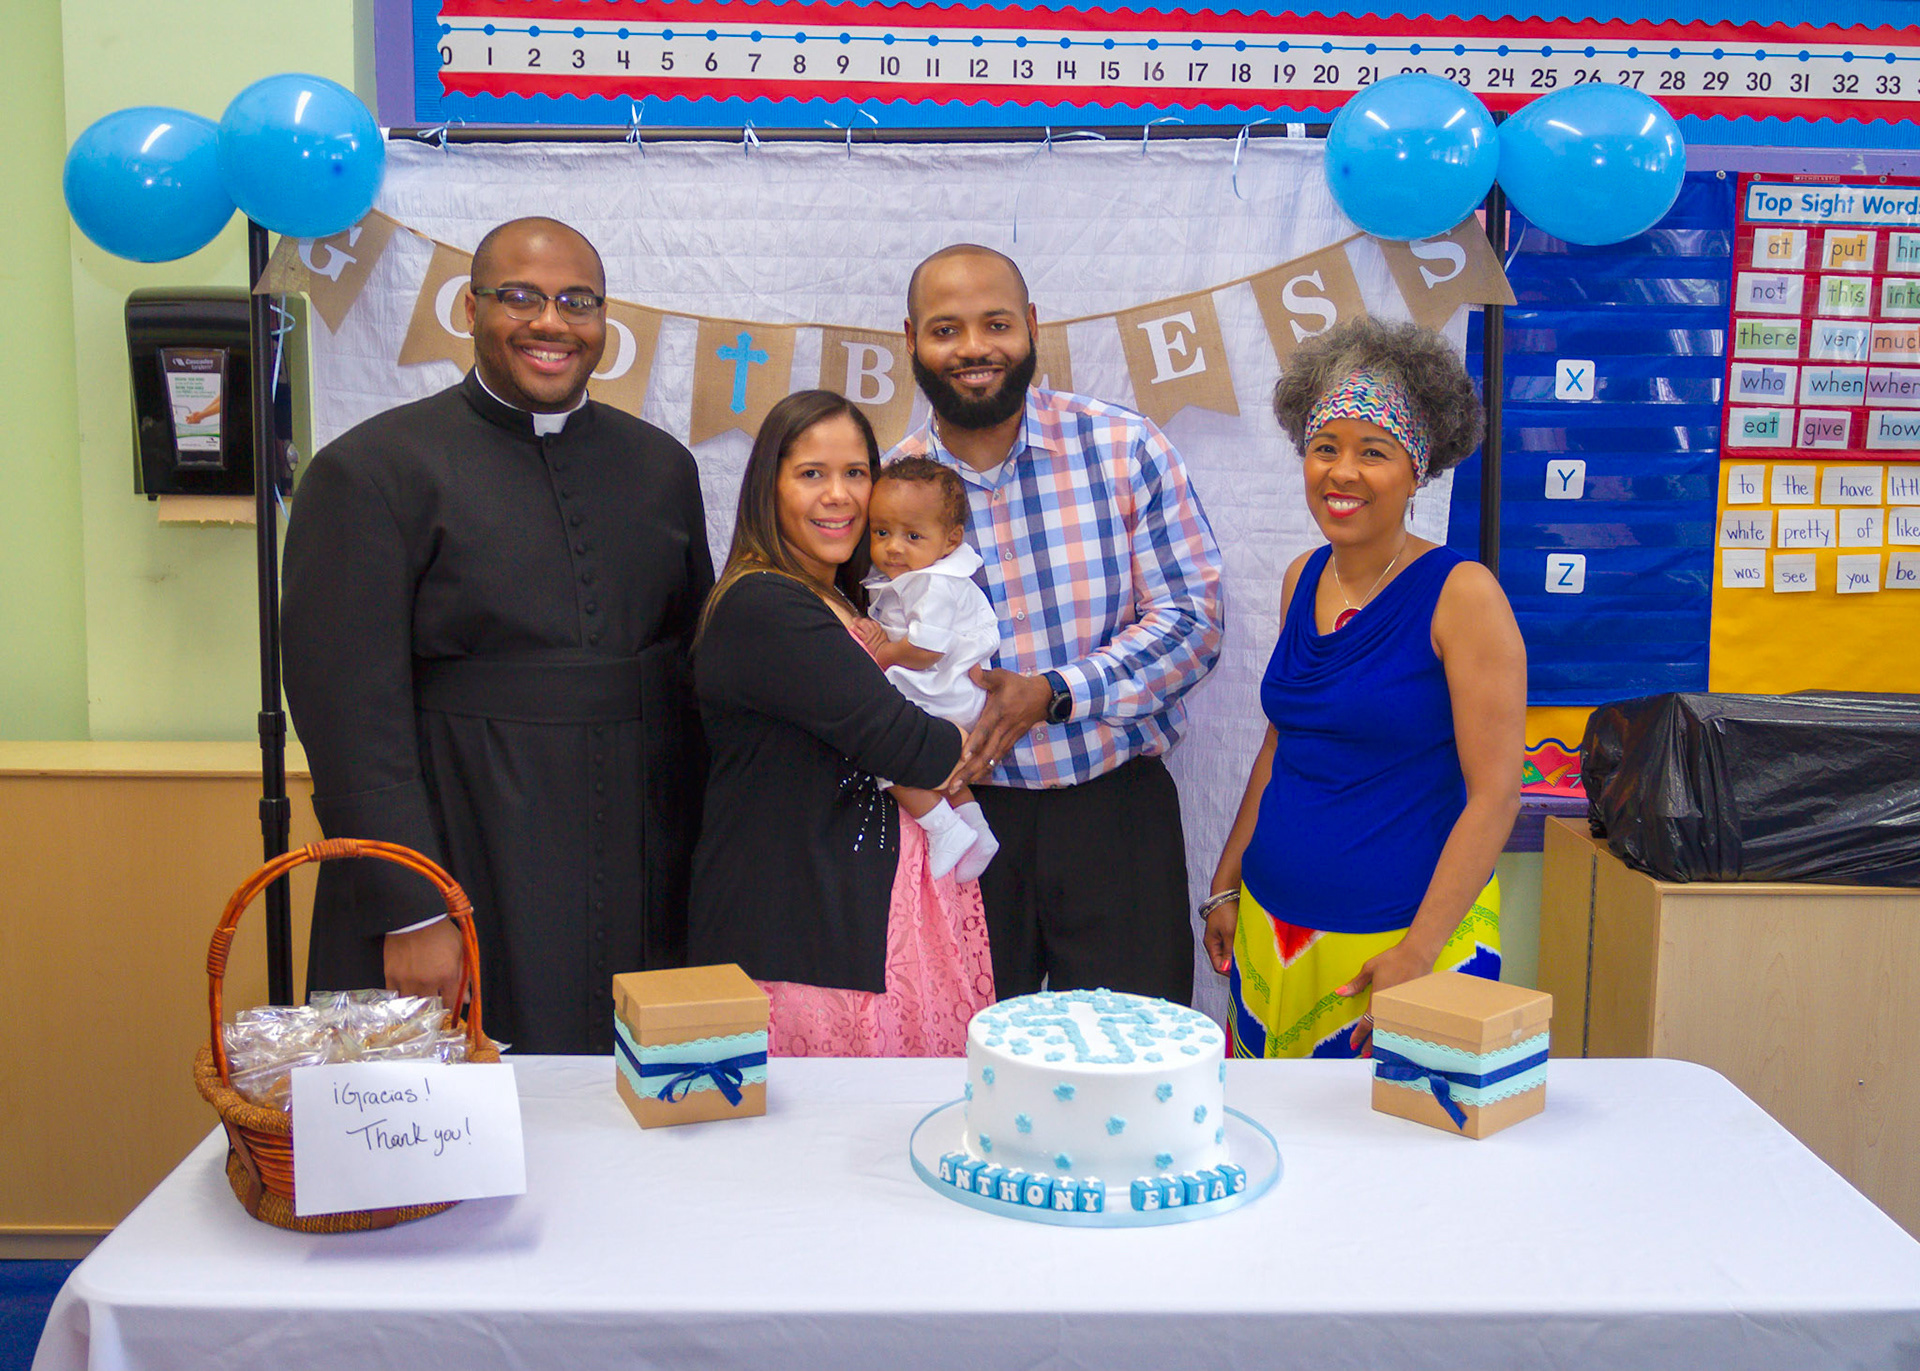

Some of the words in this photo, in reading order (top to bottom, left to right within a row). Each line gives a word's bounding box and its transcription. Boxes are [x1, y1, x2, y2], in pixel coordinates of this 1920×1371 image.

[440, 45, 453, 66] 0
[528, 48, 541, 67] 2
[572, 49, 585, 69] 3
[617, 50, 630, 70] 4
[661, 51, 674, 71] 5
[705, 52, 718, 72] 6
[748, 53, 762, 72] 7
[793, 54, 806, 74] 8
[836, 55, 850, 74] 9
[880, 56, 900, 76] 10
[926, 58, 940, 77] 11
[970, 59, 988, 78] 12
[1013, 59, 1034, 79] 13
[1057, 60, 1077, 80] 14
[1101, 61, 1120, 80] 15
[1144, 62, 1165, 81] 16
[1188, 62, 1209, 82] 17
[1232, 63, 1252, 83] 18
[1274, 64, 1296, 84] 19
[1313, 64, 1340, 84] 20
[1357, 66, 1379, 85] 21
[1487, 68, 1515, 88] 24
[1530, 68, 1558, 88] 25
[1618, 70, 1645, 89] 27
[1659, 70, 1686, 90] 28
[1702, 71, 1729, 91] 29
[1746, 72, 1772, 92] 30
[1789, 73, 1810, 93] 31
[1832, 74, 1859, 94] 32
[1875, 75, 1901, 95] 33
[1755, 192, 1793, 216] Top
[1801, 193, 1856, 218] Sight
[1862, 195, 1920, 215] Word
[1768, 238, 1791, 256] at
[1831, 238, 1867, 266] put
[1752, 282, 1787, 301] not
[1827, 280, 1865, 304] this
[1739, 324, 1798, 347] there
[1823, 332, 1867, 359] very
[1873, 335, 1920, 350] muc
[1565, 368, 1585, 392] X
[1742, 368, 1785, 391] who
[1811, 370, 1864, 393] when
[1744, 416, 1779, 434] eat
[1804, 414, 1844, 446] give
[1880, 414, 1920, 436] how
[1557, 468, 1577, 491] Y
[1738, 474, 1755, 495] to
[1782, 475, 1809, 496] the
[1839, 476, 1874, 497] have
[1726, 519, 1765, 541] white
[1784, 519, 1830, 547] pretty
[1857, 517, 1874, 538] of
[1896, 516, 1920, 537] like
[1557, 562, 1576, 586] Z
[1733, 565, 1761, 580] was
[1782, 571, 1808, 584] see
[1845, 573, 1872, 590] you
[1895, 560, 1917, 581] be
[346, 1118, 428, 1151] Thank
[433, 1116, 472, 1157] you!
[938, 1161, 1100, 1212] ANTHONY
[1142, 1174, 1245, 1211] ELIAS
